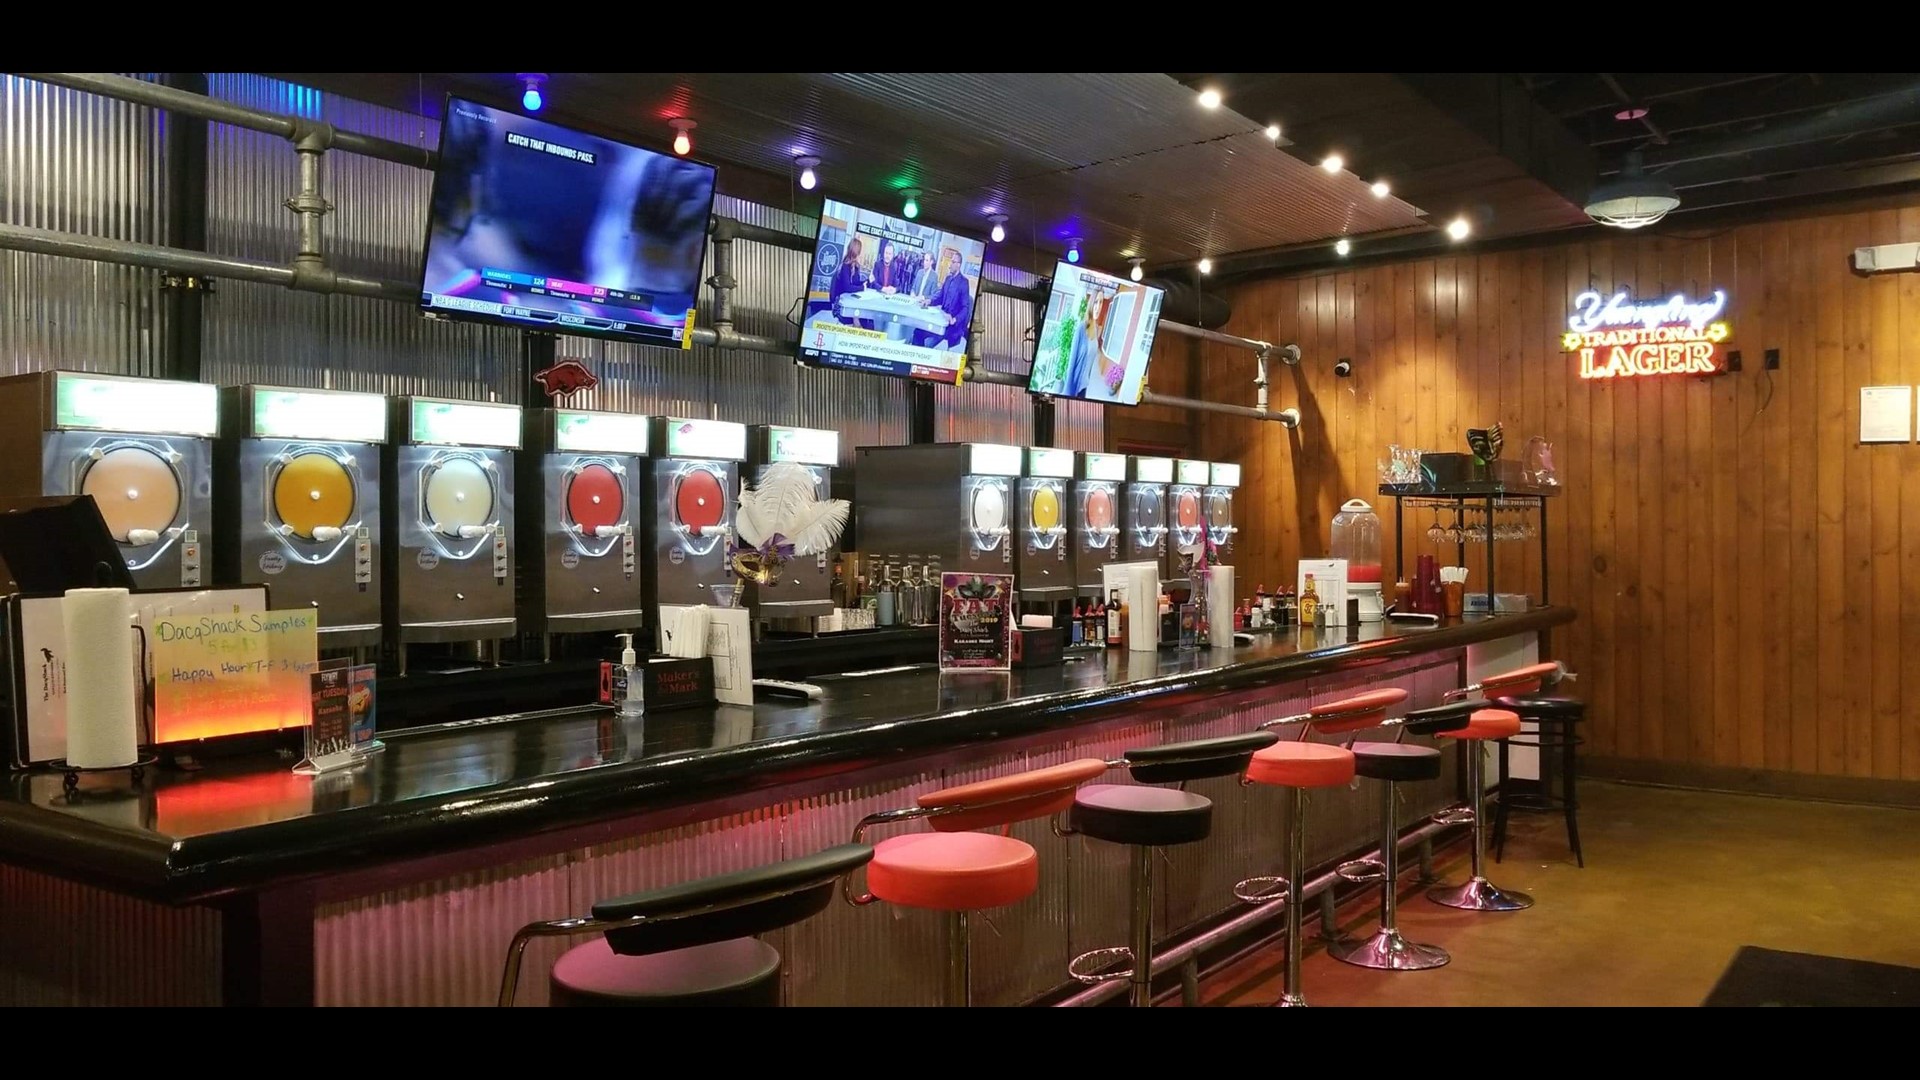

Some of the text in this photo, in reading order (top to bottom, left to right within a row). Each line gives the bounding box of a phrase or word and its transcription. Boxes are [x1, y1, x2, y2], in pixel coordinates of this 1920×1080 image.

[508, 133, 529, 147] CATCH
[530, 138, 545, 151] THAT
[545, 143, 577, 159] INBOUNDS
[533, 278, 545, 286] 124
[593, 288, 605, 296] 123
[502, 305, 514, 315] FORT
[1582, 326, 1708, 347] TRADITIONAL
[1580, 342, 1716, 379] LAGER
[952, 597, 1000, 615] FAT
[250, 614, 306, 634] Samples
[172, 667, 215, 685] Happy
[221, 662, 247, 675] Hour
